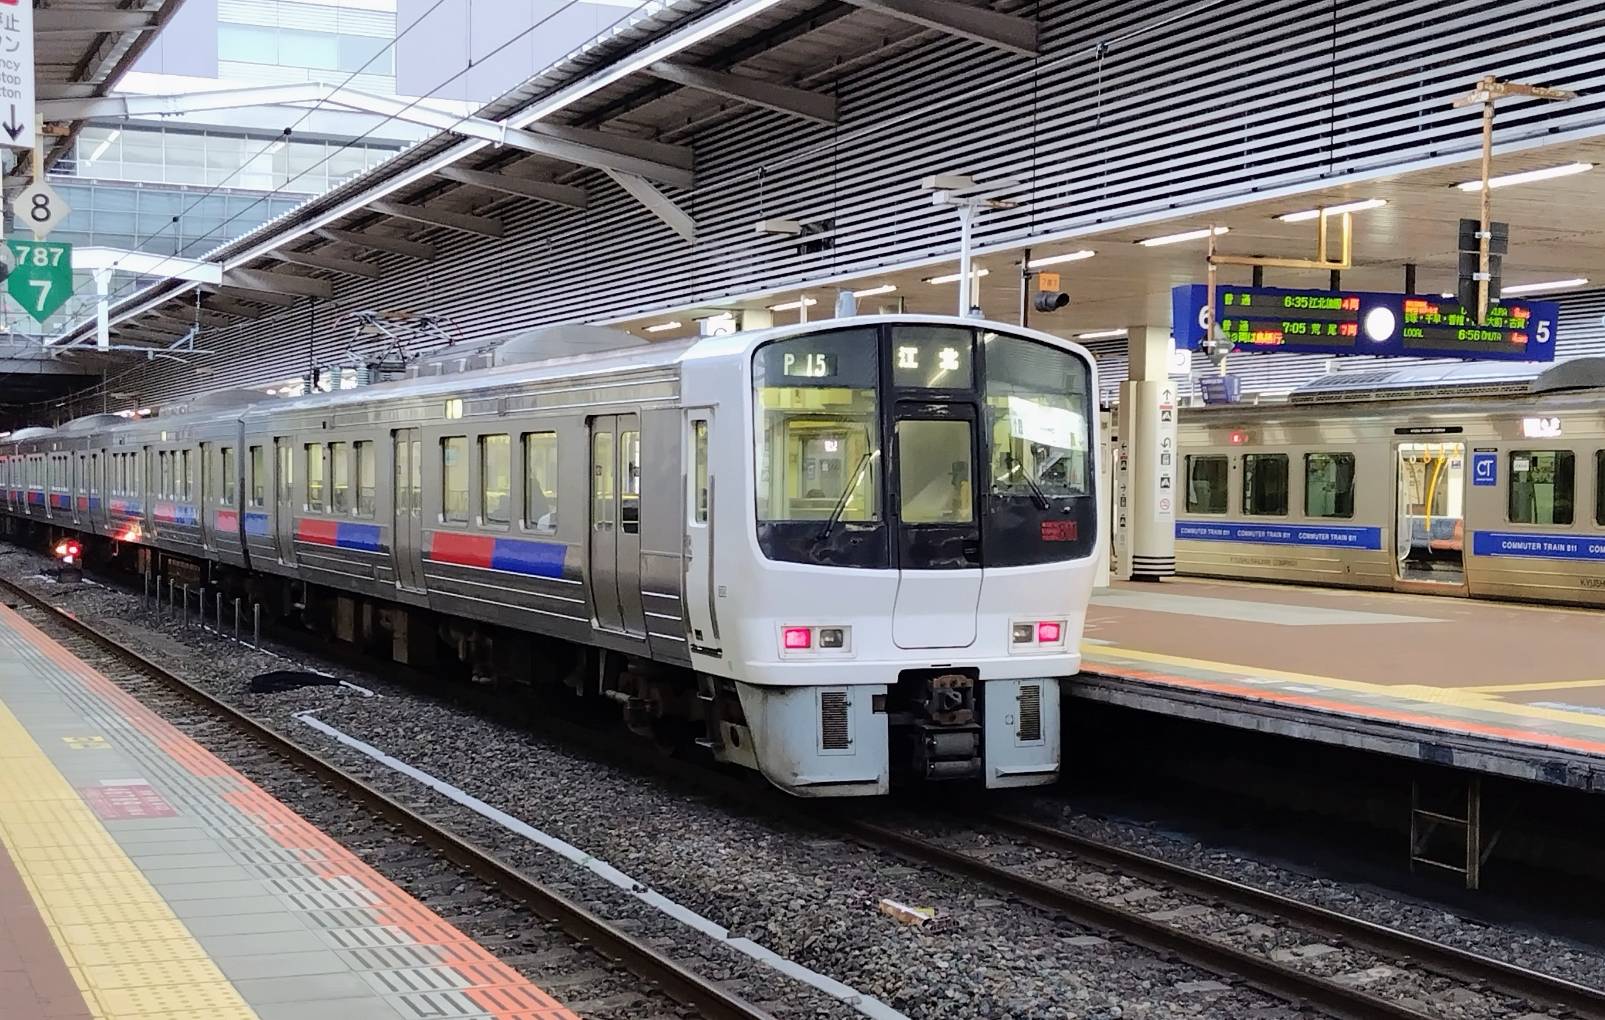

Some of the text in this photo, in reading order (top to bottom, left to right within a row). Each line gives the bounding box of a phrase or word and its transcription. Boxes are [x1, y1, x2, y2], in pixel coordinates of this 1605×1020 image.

[0, 72, 21, 86] top
[31, 193, 51, 222] 8
[15, 245, 64, 267] 787
[29, 280, 52, 311] 7
[1284, 296, 1308, 308] 6:35
[1282, 322, 1306, 334] 7:05
[1458, 329, 1480, 341] 6:56
[1536, 320, 1550, 343] 5
[784, 353, 795, 376] P
[1477, 460, 1494, 477] CT
[1330, 533, 1348, 542] TRAIN
[1502, 541, 1541, 550] COMMUTER
[1543, 543, 1565, 552] TRAIN
